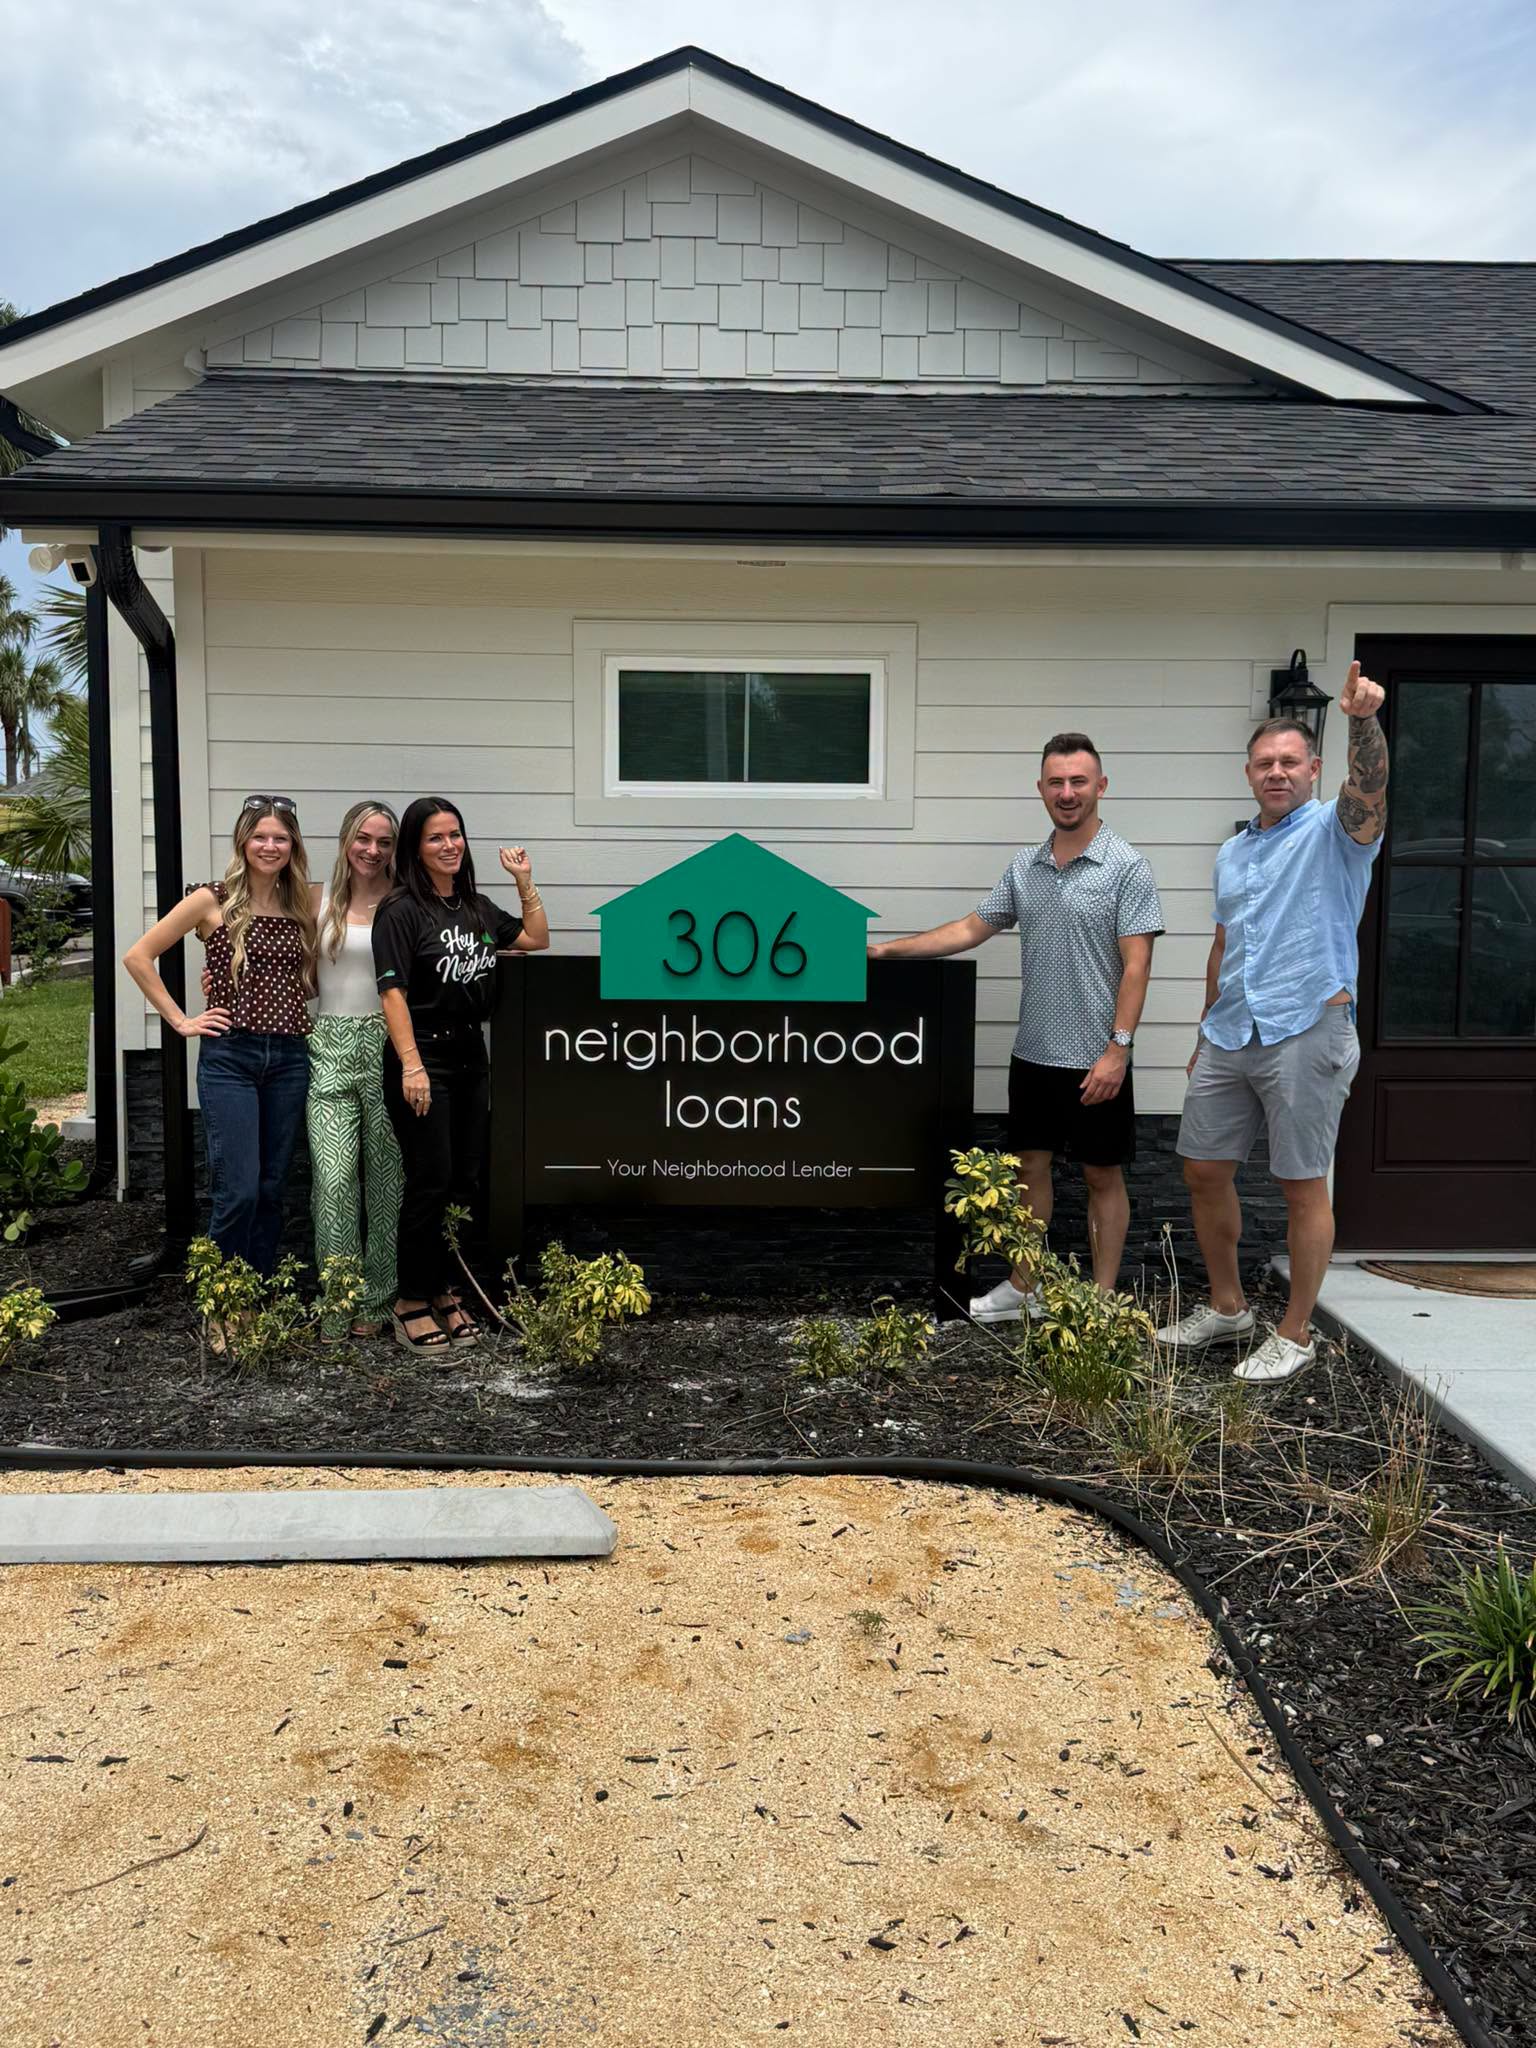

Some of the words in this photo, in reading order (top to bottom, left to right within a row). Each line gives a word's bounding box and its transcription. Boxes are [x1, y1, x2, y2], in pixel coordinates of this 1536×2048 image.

[440, 925, 480, 956] Hey
[662, 909, 808, 979] 306
[436, 946, 497, 984] Neighbo
[545, 1014, 924, 1071] neighborhood
[665, 1080, 802, 1129] loans
[607, 1159, 647, 1177] Your
[653, 1159, 786, 1180] Neighborhood
[792, 1160, 853, 1178] Lender
